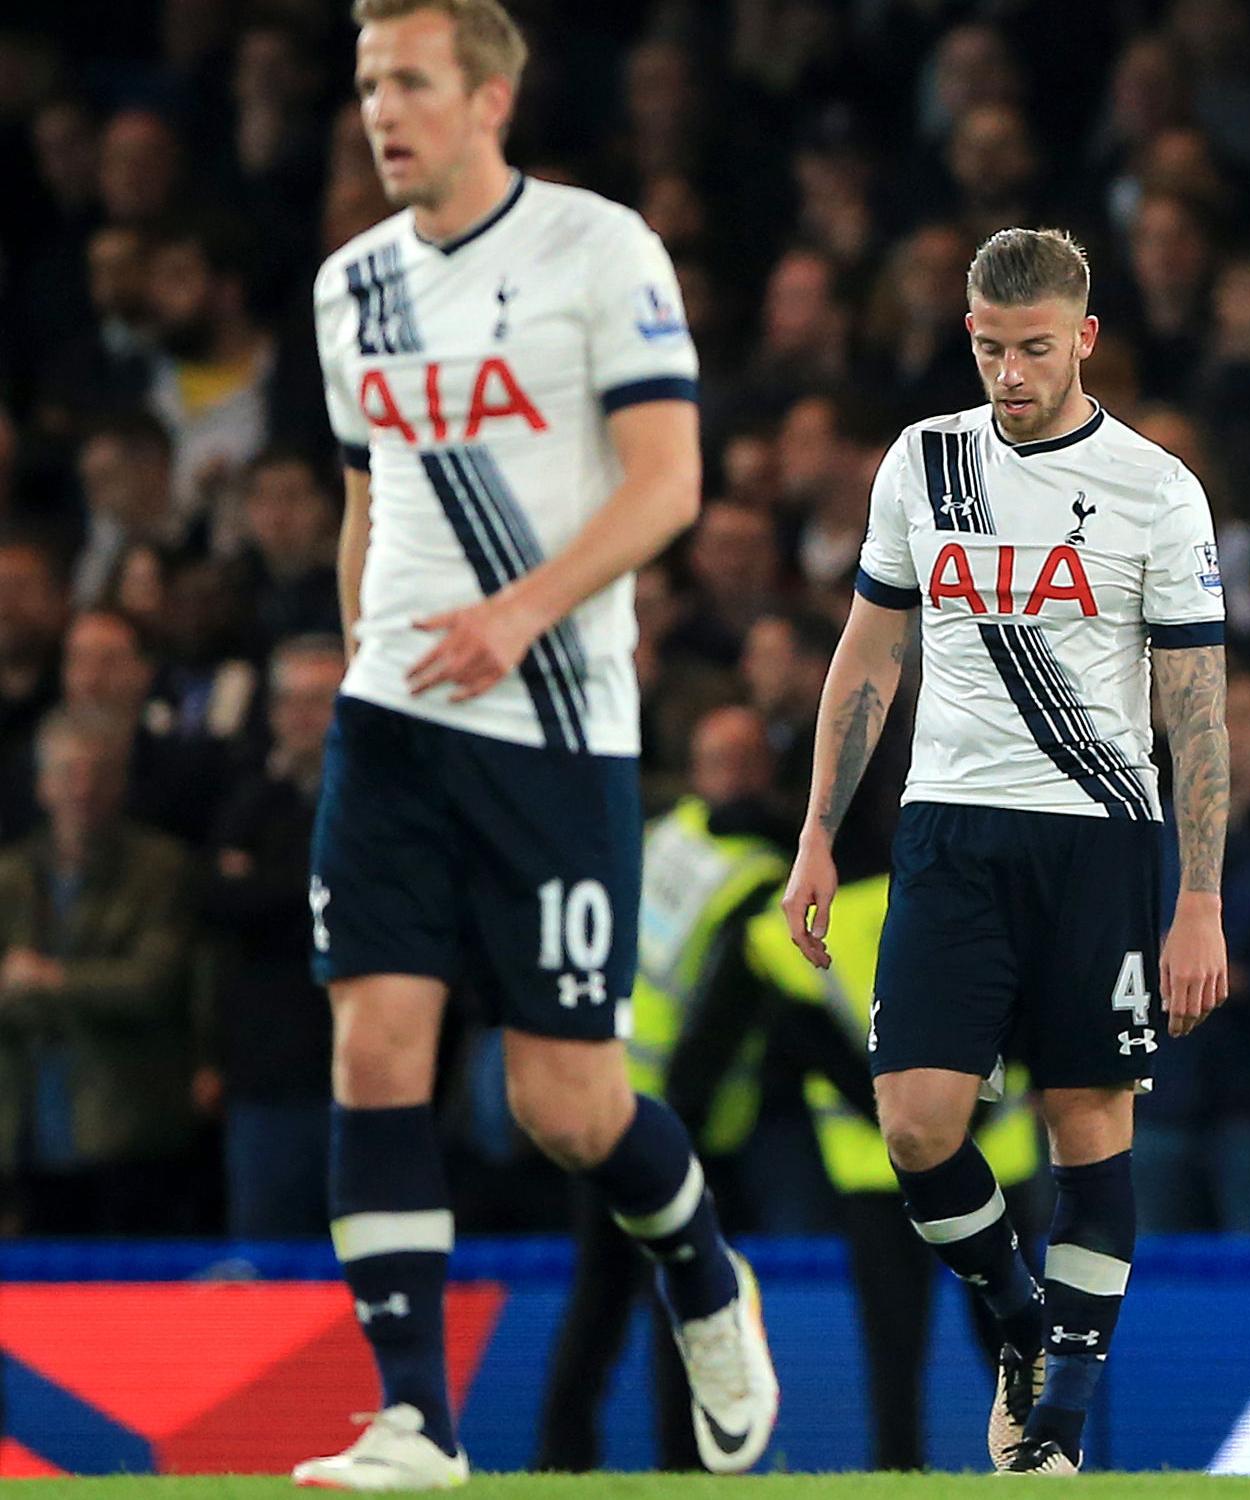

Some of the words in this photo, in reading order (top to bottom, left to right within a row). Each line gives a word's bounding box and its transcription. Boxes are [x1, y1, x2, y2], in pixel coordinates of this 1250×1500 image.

[360, 358, 548, 446] AIA
[929, 542, 1098, 617] AIA
[538, 877, 614, 970] 10
[1111, 951, 1151, 1026] 4
